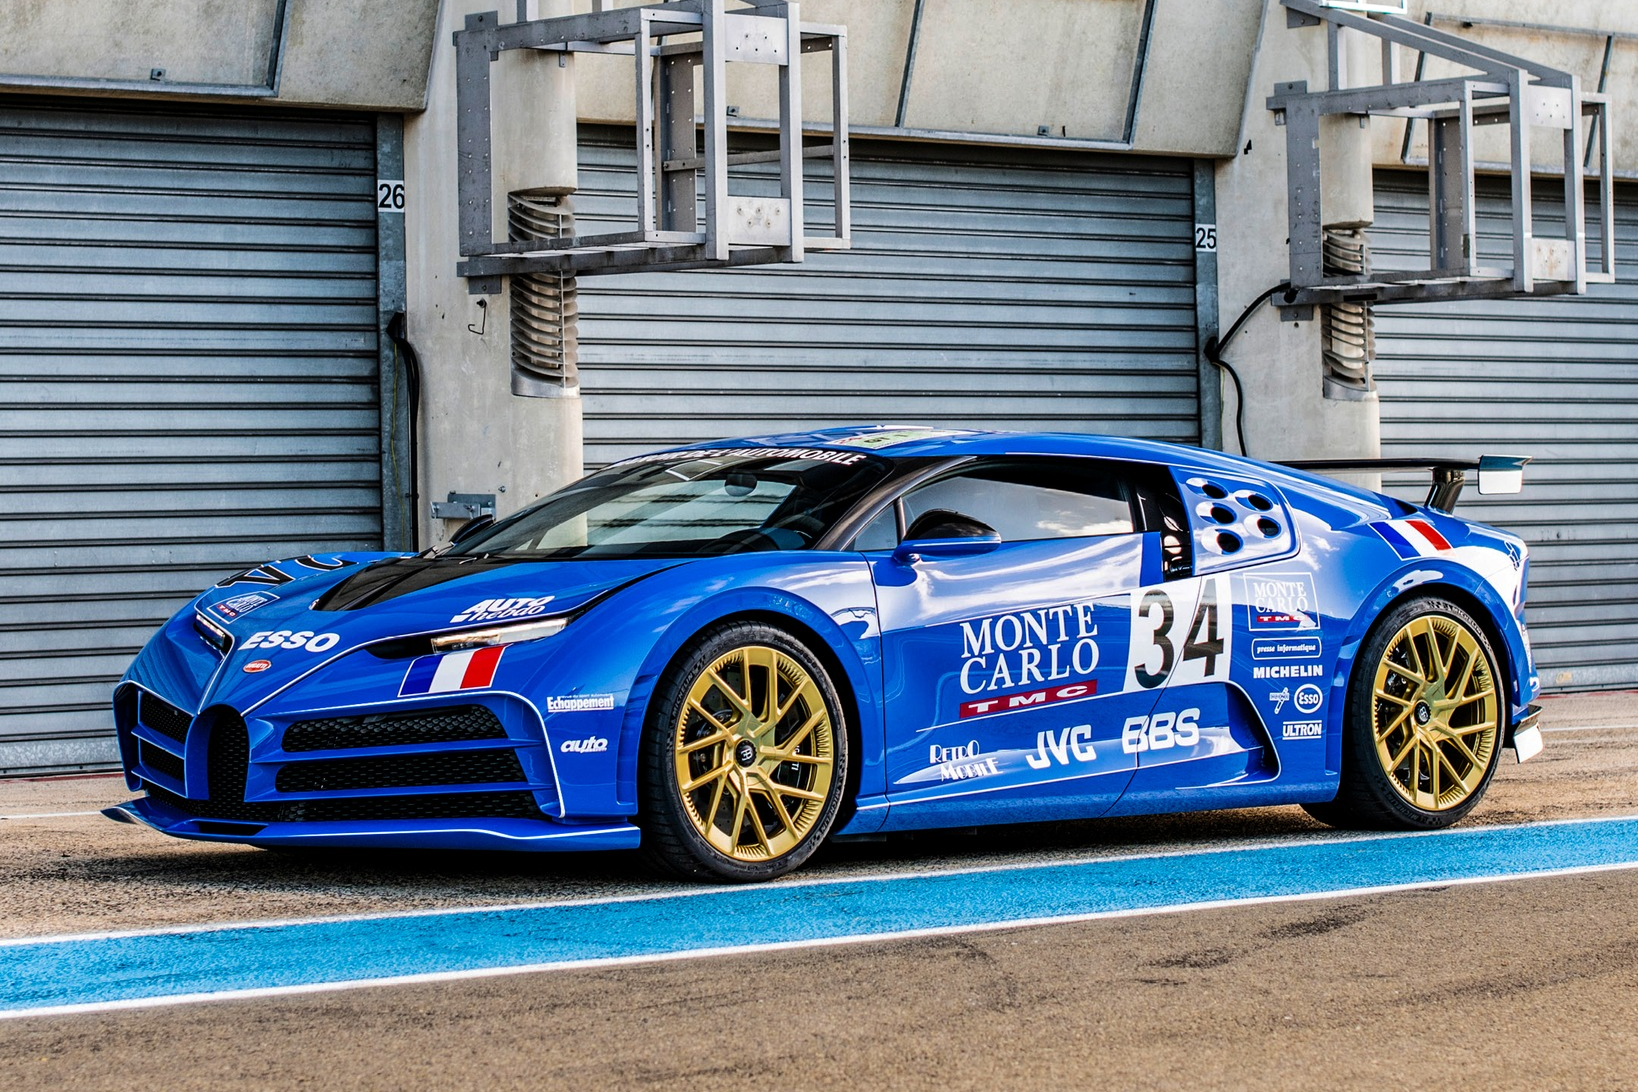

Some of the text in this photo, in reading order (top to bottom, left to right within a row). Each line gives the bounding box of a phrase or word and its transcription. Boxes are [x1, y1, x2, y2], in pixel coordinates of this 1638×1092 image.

[379, 183, 405, 209] 26
[1195, 227, 1216, 249] 25
[1253, 581, 1307, 597] MONTE
[461, 595, 555, 614] AUTO
[467, 606, 545, 621] hebdo
[1255, 596, 1308, 613] CARLO
[238, 630, 340, 652] ESSO
[960, 602, 1098, 659] MONTE
[1134, 578, 1224, 689] 34
[1257, 646, 1275, 654] presse
[1277, 644, 1316, 653] informatique
[959, 638, 1099, 695] CARLO
[1253, 665, 1323, 679] MICHELIN
[672, 672, 694, 717] MICHELIN
[968, 685, 1088, 713] TMC
[1121, 707, 1201, 754] BBS
[1282, 723, 1322, 737] ULTRON
[560, 736, 609, 754] auto
[1025, 724, 1097, 770] JVC
[940, 757, 1004, 782] MOBILE
